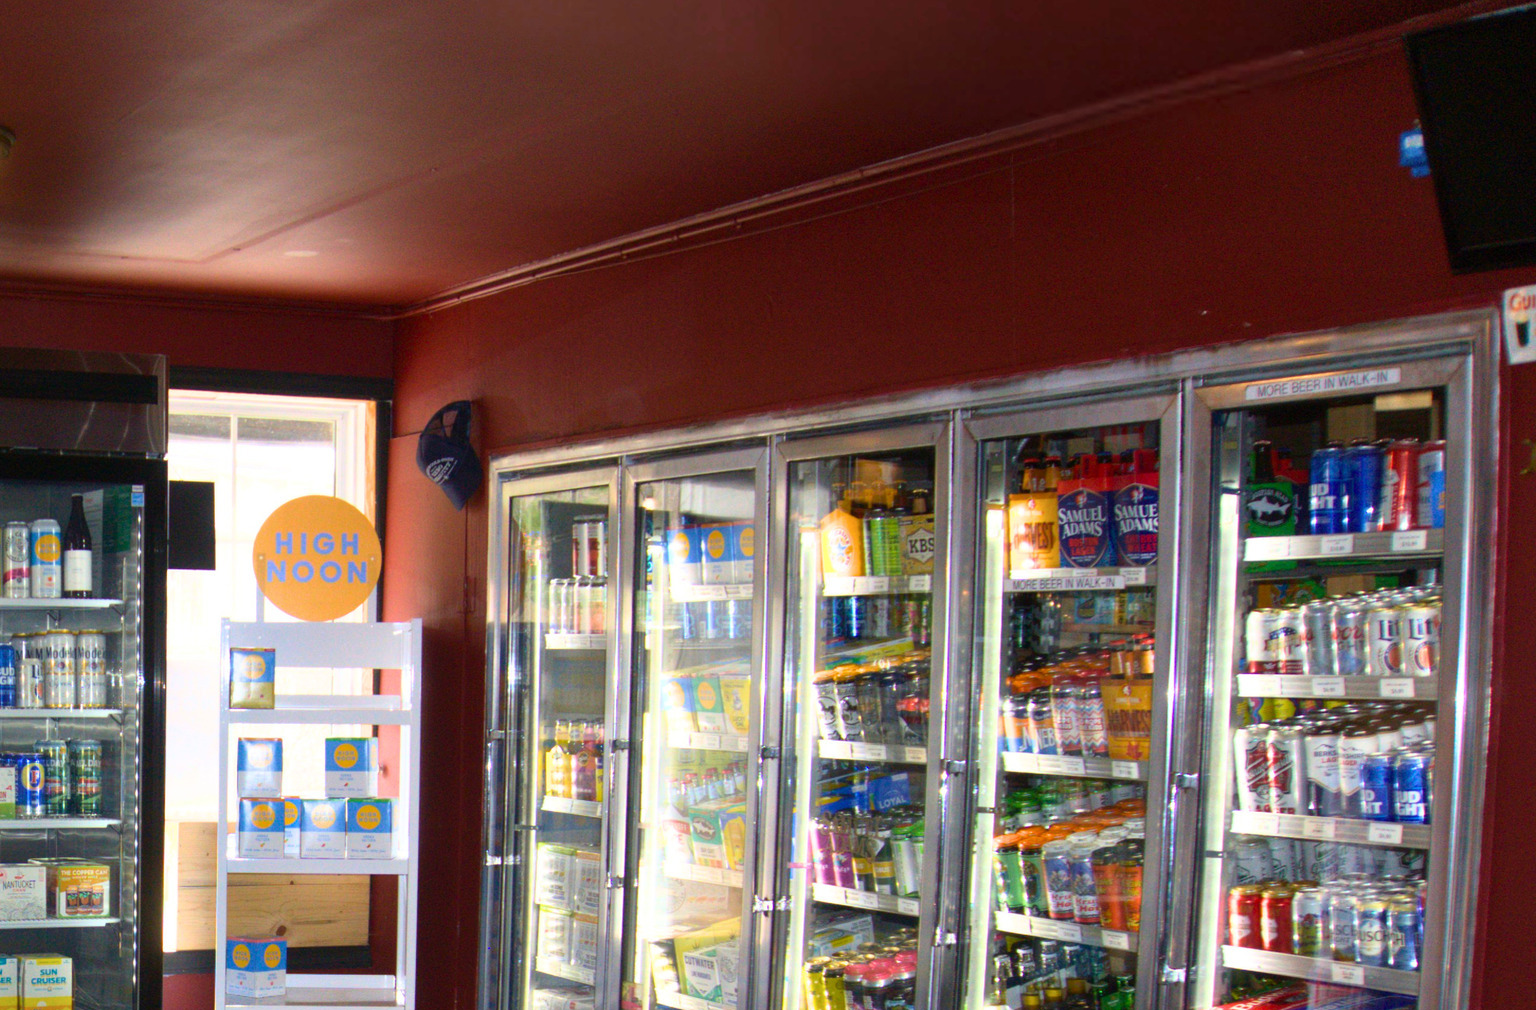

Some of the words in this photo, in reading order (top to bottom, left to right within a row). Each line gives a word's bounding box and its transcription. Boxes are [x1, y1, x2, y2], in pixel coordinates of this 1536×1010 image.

[1256, 382, 1289, 397] MORE
[1292, 379, 1321, 394] BEER
[1324, 378, 1336, 390] IN
[1338, 372, 1388, 388] WALK-IN
[1310, 483, 1329, 496] UD
[1058, 505, 1107, 525] SAMUEL
[1114, 503, 1158, 521] SAMUE
[1062, 521, 1103, 540] ADAMS
[275, 532, 359, 555] HIGH
[909, 539, 935, 554] KBS
[266, 560, 368, 584] NOON
[1013, 579, 1037, 590] MORE
[1039, 578, 1063, 589] BEER
[1065, 578, 1074, 588] IN
[1076, 577, 1115, 588] WALK-IN
[879, 795, 906, 809] LOYAL
[1398, 791, 1421, 802] UD
[1396, 803, 1425, 814] GHT
[2, 879, 36, 890] NANTUCKET
[684, 955, 714, 970] CUTWATER
[31, 977, 67, 985] CRUISER
